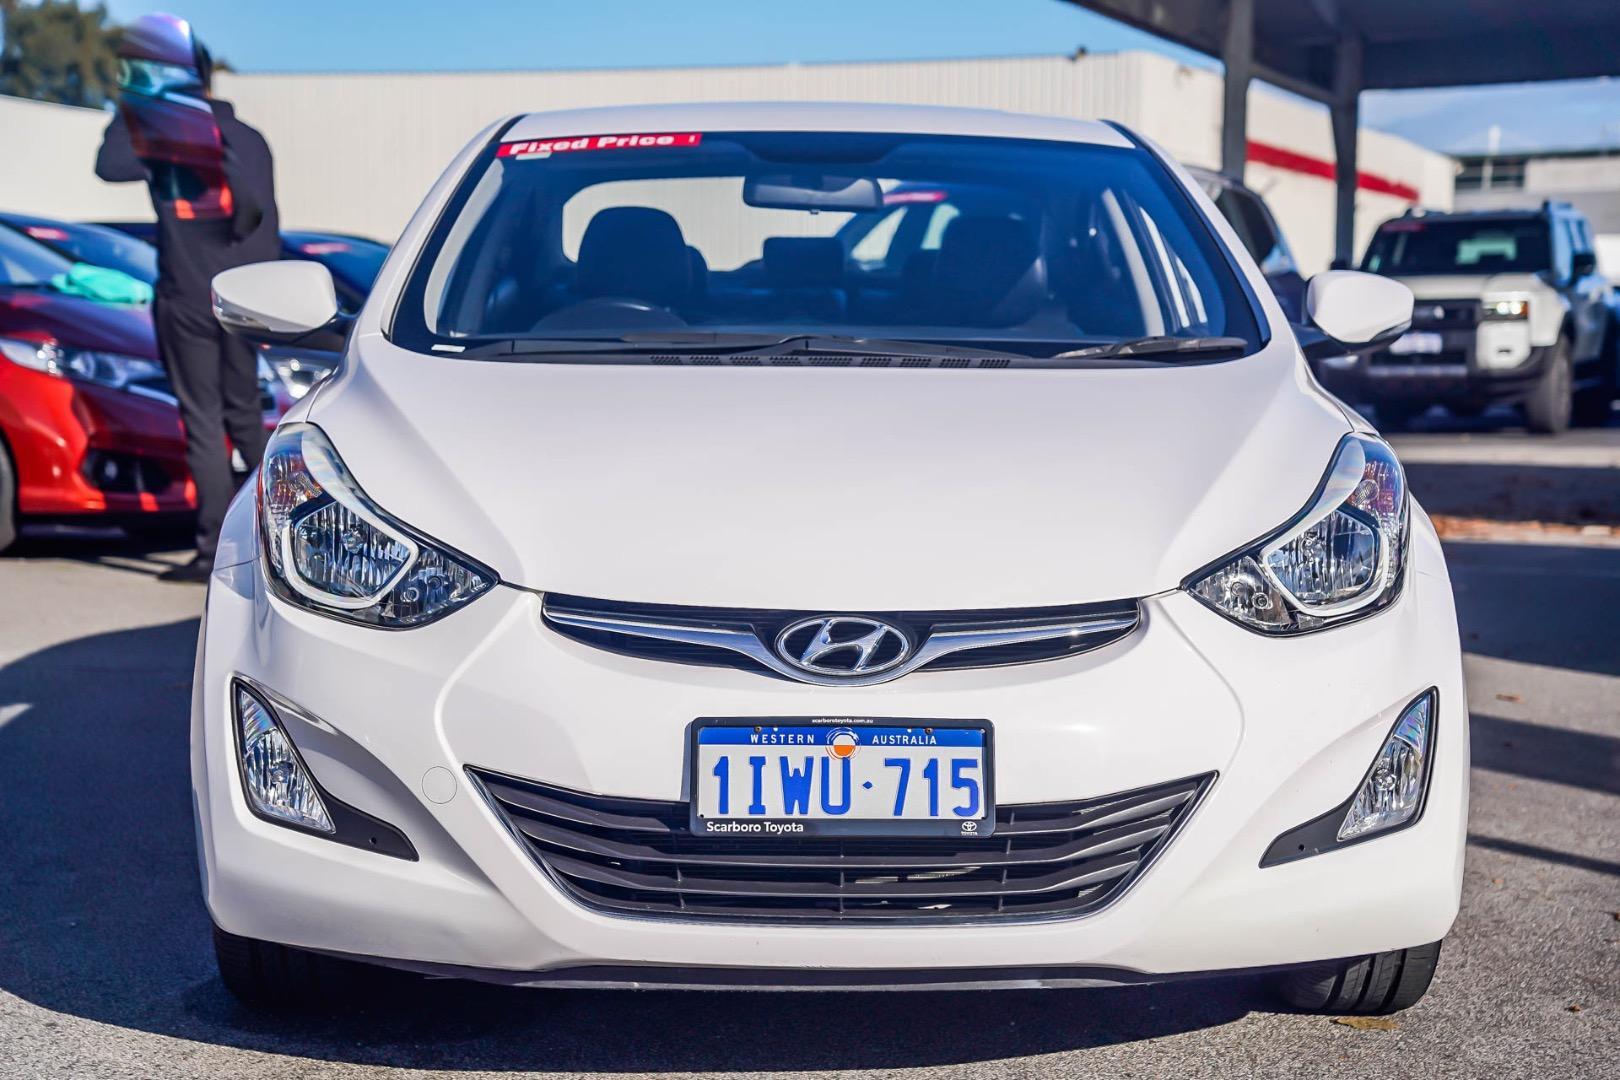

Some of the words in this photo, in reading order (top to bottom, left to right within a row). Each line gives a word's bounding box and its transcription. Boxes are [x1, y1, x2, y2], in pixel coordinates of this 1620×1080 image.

[509, 138, 589, 155] Fixed
[596, 134, 675, 148] Price
[750, 733, 815, 744] WESTERN
[872, 734, 937, 745] AUSTRALIA
[706, 821, 762, 833] Scarboro
[763, 821, 804, 835] Toyota
